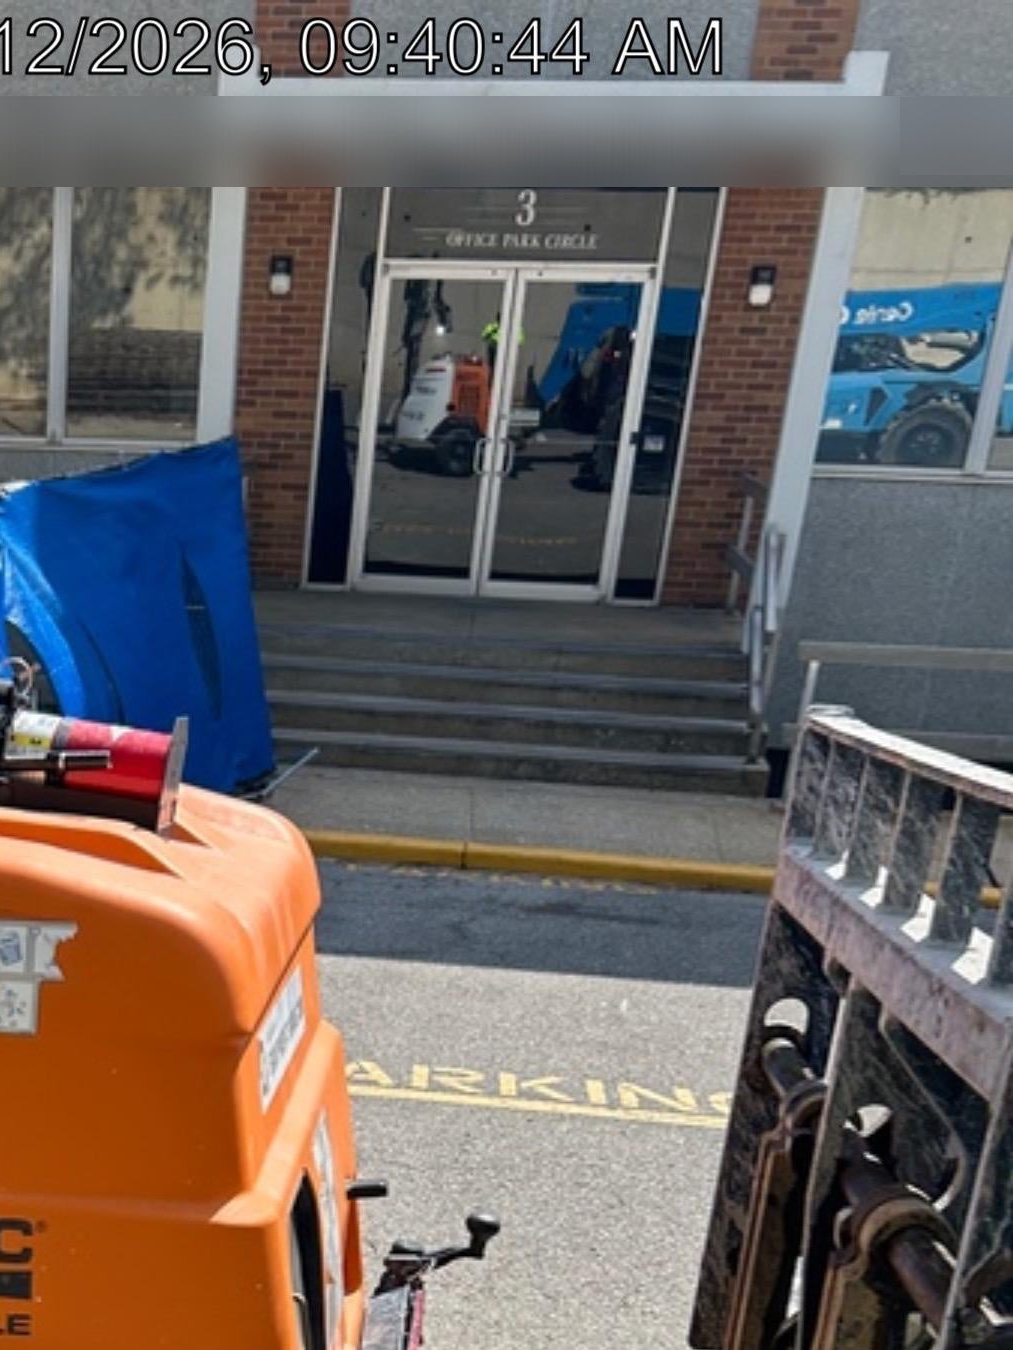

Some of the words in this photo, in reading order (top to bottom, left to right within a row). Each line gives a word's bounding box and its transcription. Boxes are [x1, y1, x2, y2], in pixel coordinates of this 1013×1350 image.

[514, 188, 537, 226] 3
[445, 231, 497, 248] OFFICE
[502, 232, 541, 249] PARK
[544, 232, 599, 250] CIRCLE
[345, 1060, 733, 1114] ARKIN
